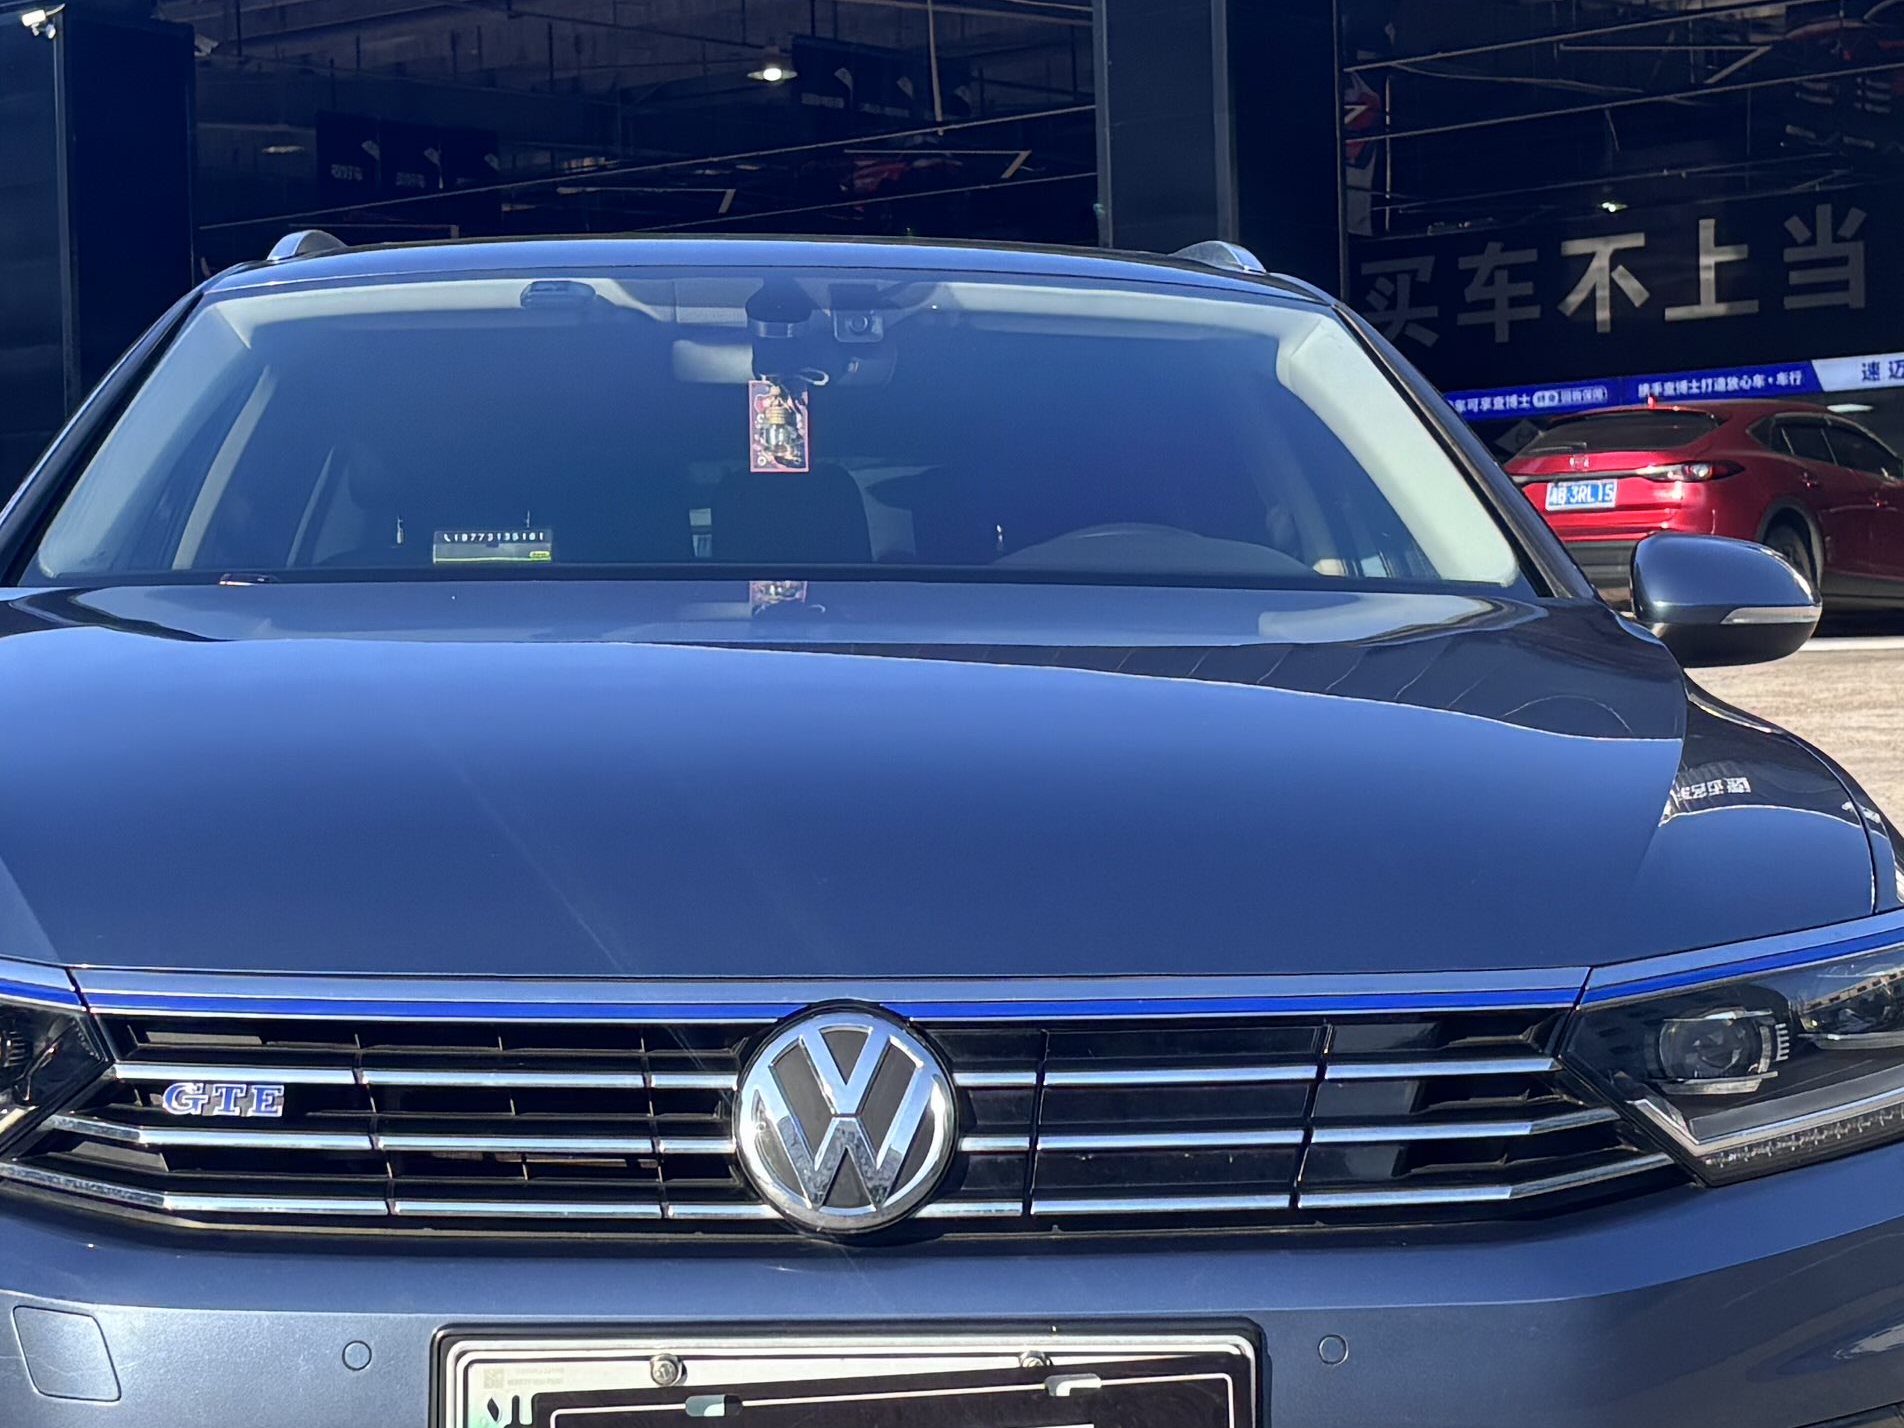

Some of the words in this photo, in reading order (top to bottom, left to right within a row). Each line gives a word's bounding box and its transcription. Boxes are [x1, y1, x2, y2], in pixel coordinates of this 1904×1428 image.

[1360, 202, 1868, 347] 买车不上当
[162, 1082, 286, 1118] GTE
